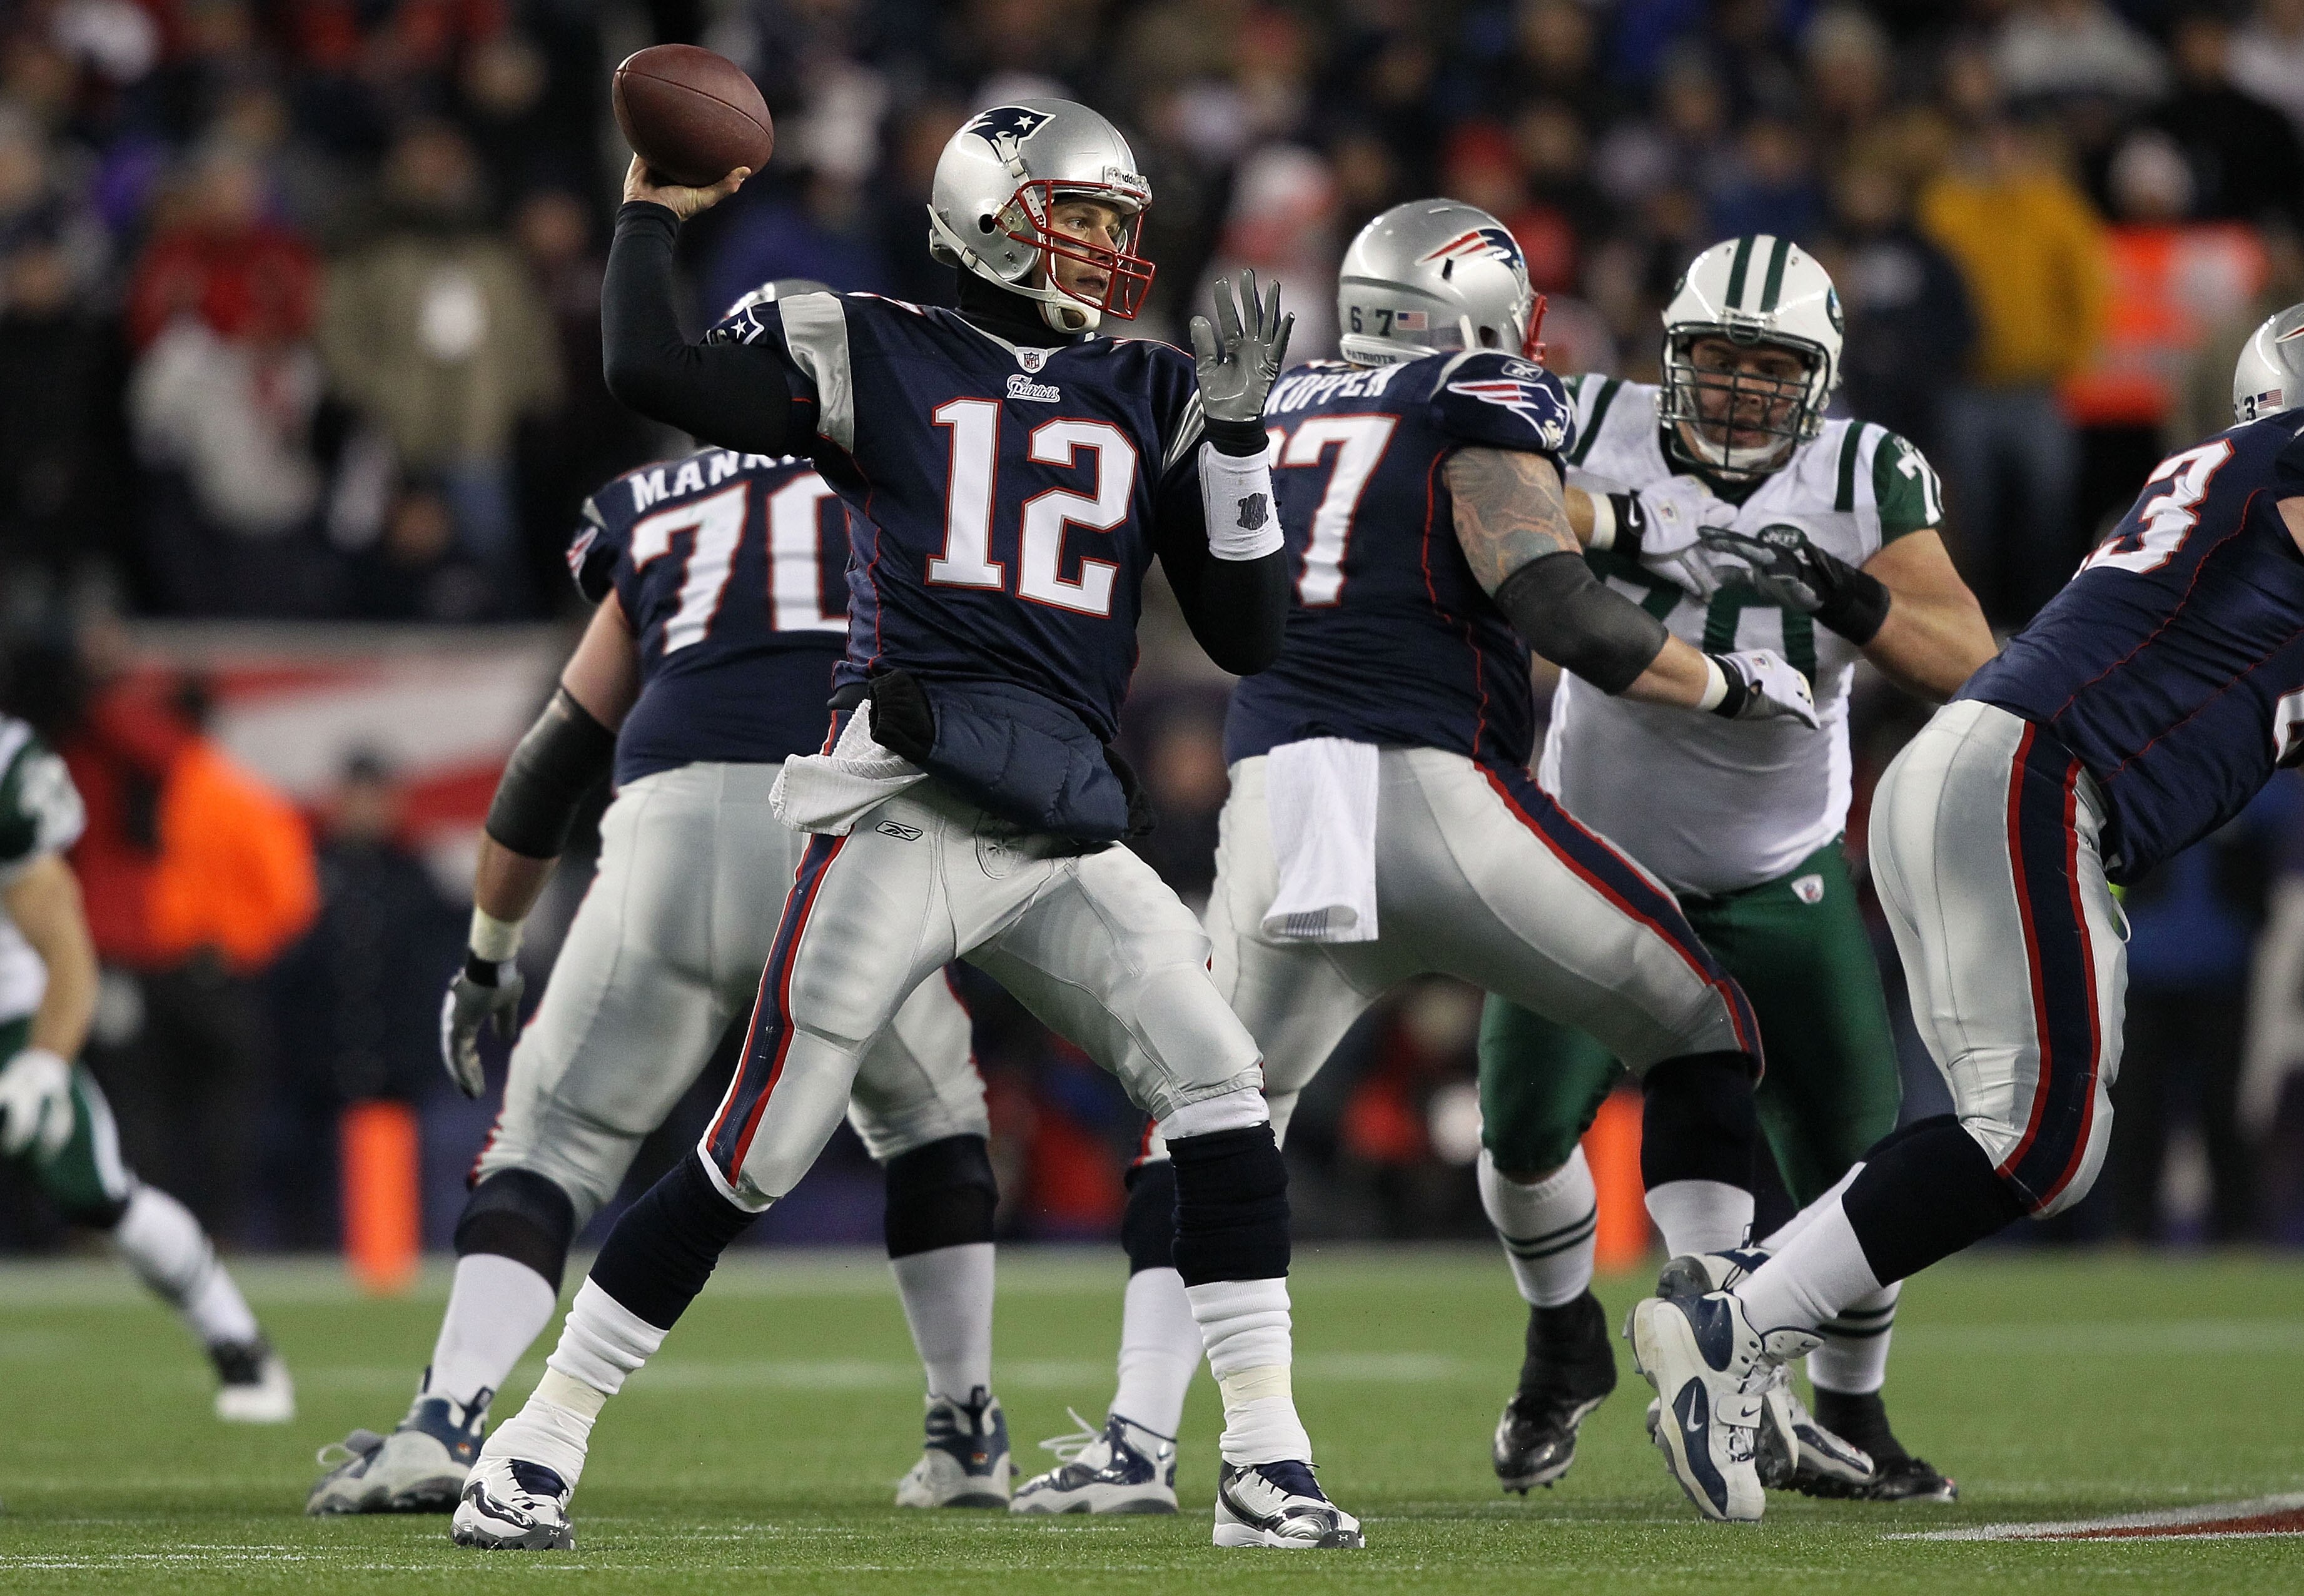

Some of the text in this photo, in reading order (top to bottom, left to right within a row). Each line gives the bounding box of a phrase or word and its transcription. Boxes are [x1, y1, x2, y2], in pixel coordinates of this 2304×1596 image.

[1008, 379, 1058, 399] Patriots
[1026, 359, 1039, 368] NFL
[1347, 349, 1397, 364] PATRIOTS
[629, 470, 849, 655] 70
[924, 396, 1138, 619] 12
[1266, 412, 1402, 609] 7
[2071, 438, 2236, 580] 3
